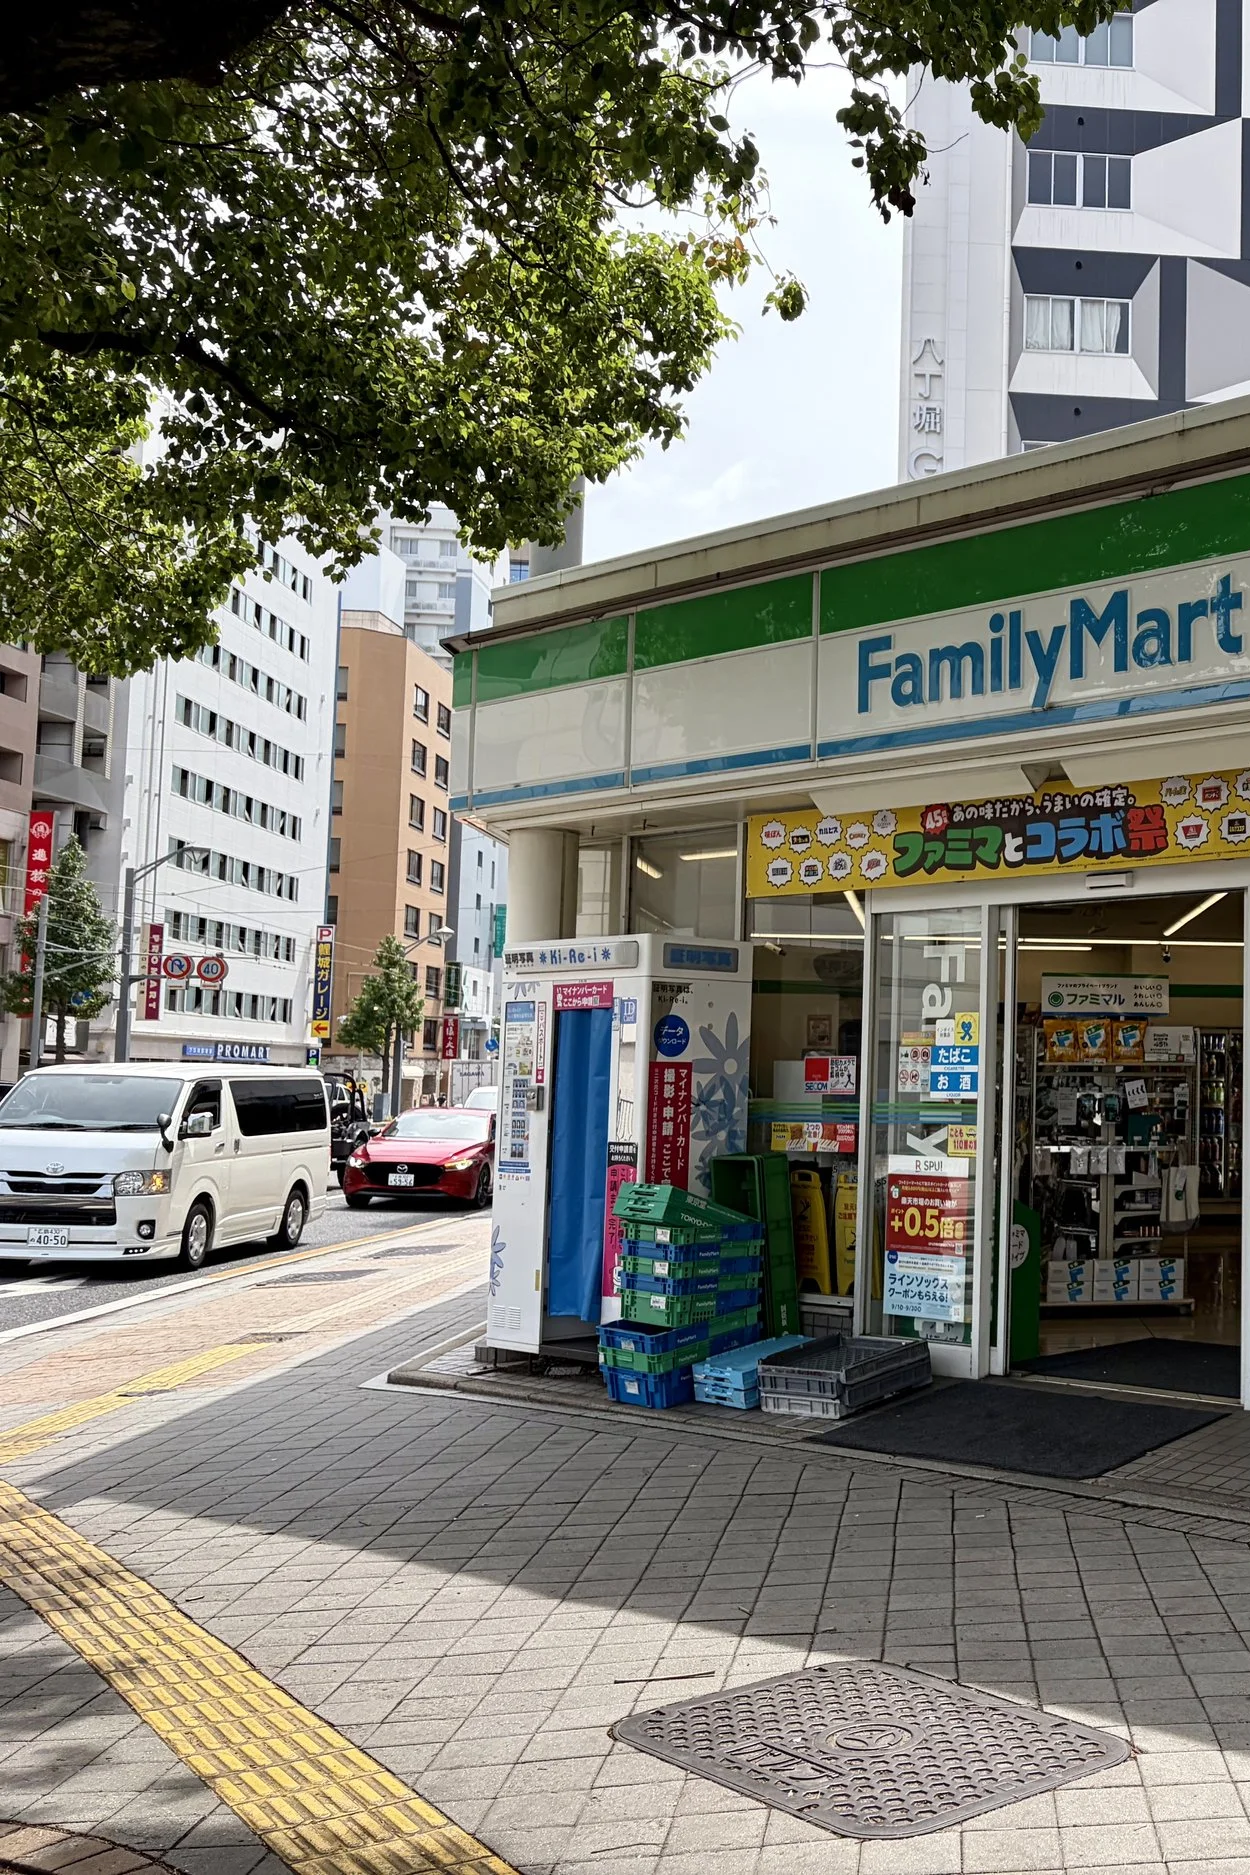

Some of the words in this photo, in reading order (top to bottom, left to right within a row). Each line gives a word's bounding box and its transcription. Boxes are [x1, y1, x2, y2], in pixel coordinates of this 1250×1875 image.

[857, 572, 1243, 713] FamilyMart
[953, 787, 1135, 822] あの味だから、うまいの確定。
[819, 826, 839, 835] カルピス
[895, 806, 1166, 874] ファミマとコラボ祭
[320, 929, 332, 940] P
[550, 947, 597, 965] Ki-Re-i
[148, 934, 160, 1009] PROMART
[203, 963, 219, 975] 40
[562, 985, 607, 995] マイナンバーカード
[1066, 993, 1125, 1006] ファミマル
[623, 1001, 636, 1015] ID
[217, 1043, 271, 1059] PROMART
[938, 1048, 971, 1063] たばこ
[805, 1082, 828, 1091] SECOM
[676, 1069, 688, 1170] マイナンバーカード
[950, 1128, 964, 1138] こども
[924, 1160, 943, 1172] SPU!
[36, 1235, 66, 1245] 40-50
[888, 1273, 949, 1290] ラインソックス
[888, 1287, 948, 1303] クーポンもらえる!
